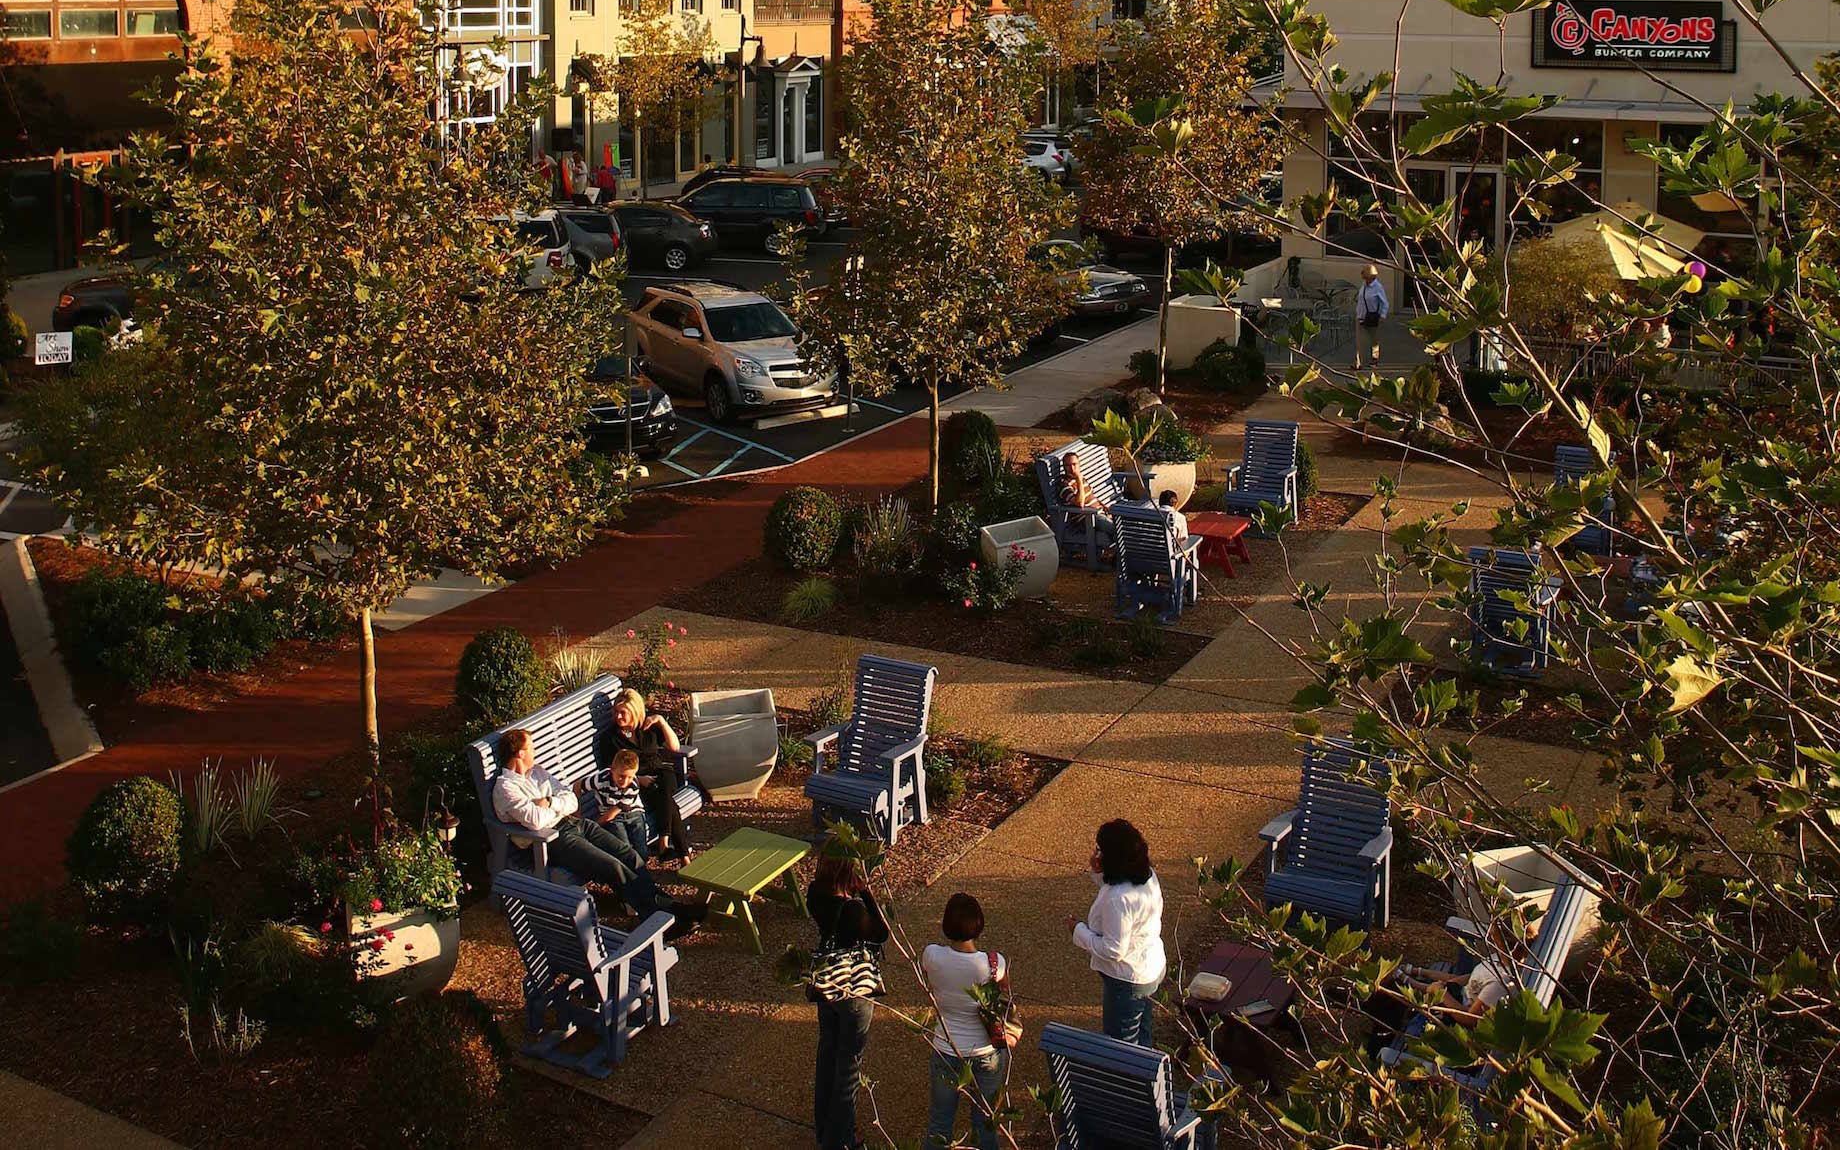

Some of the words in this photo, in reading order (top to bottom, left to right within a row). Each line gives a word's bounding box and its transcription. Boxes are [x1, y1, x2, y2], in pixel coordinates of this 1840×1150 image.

[1649, 49, 1711, 59] COMPANY
[37, 334, 57, 344] Art
[46, 343, 70, 353] Show
[38, 353, 69, 362] TODAY
